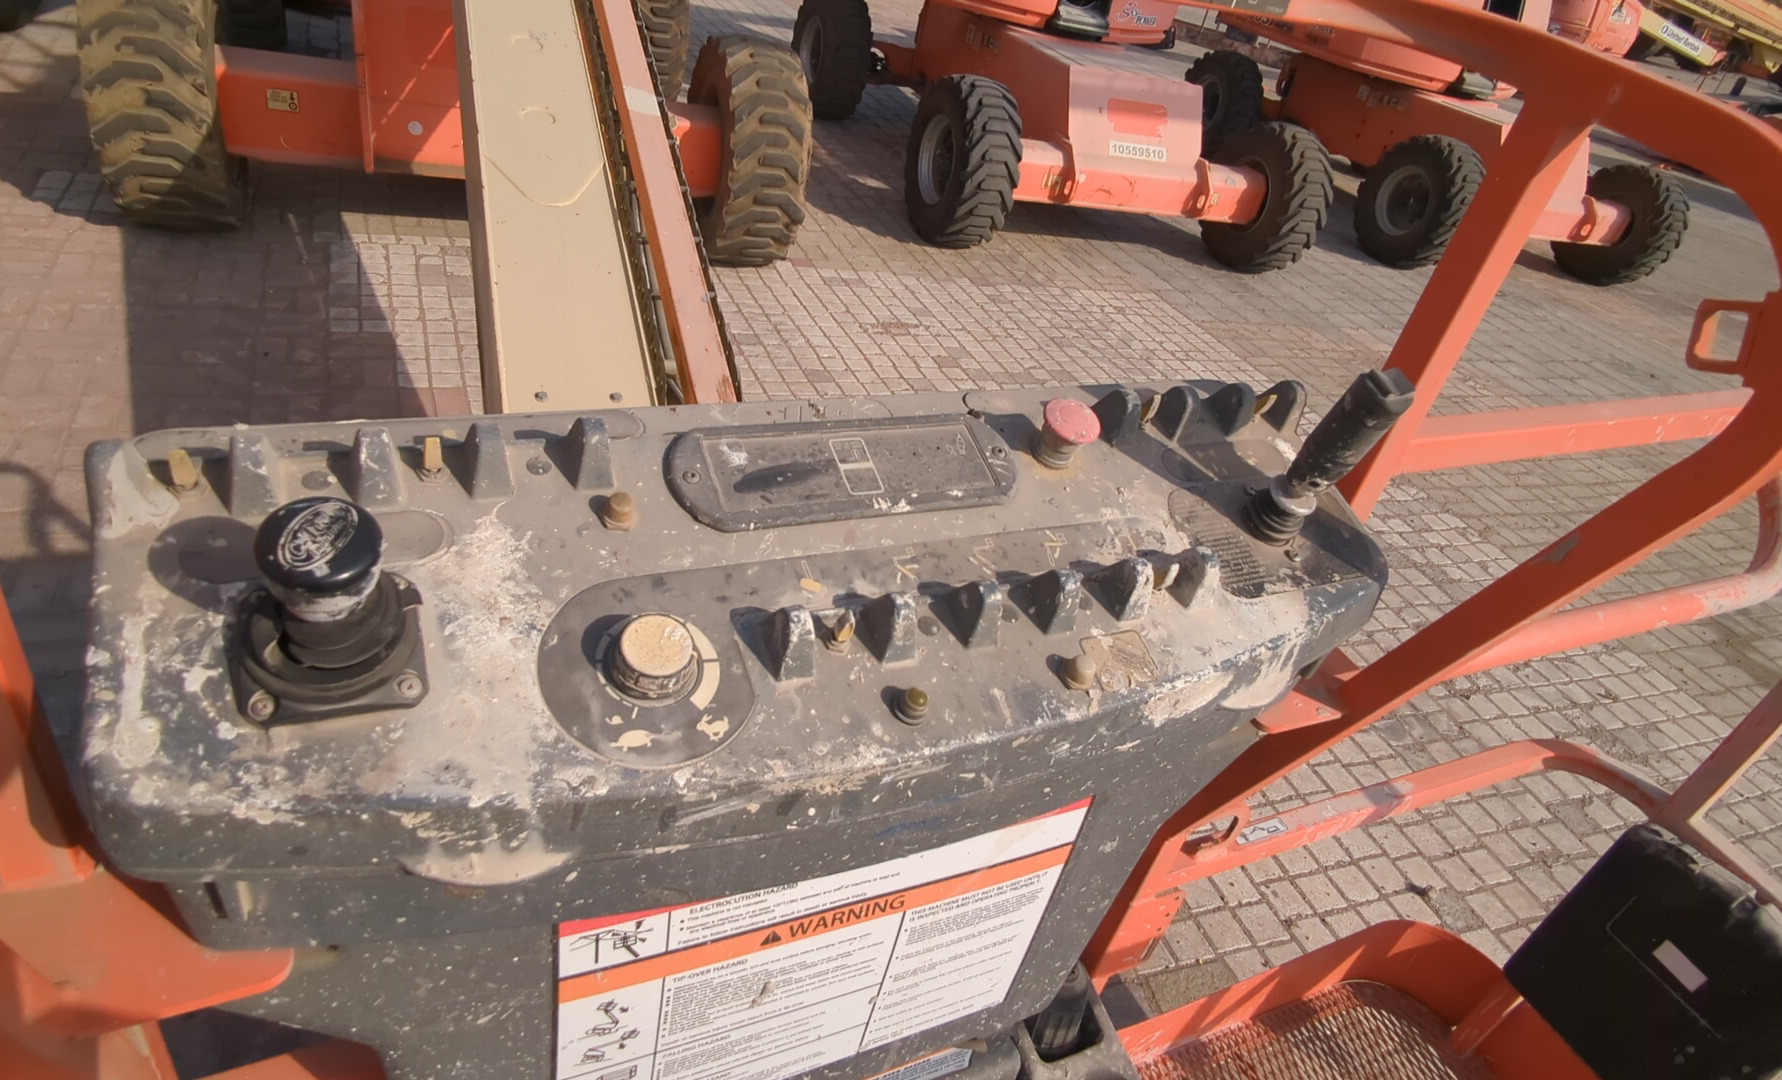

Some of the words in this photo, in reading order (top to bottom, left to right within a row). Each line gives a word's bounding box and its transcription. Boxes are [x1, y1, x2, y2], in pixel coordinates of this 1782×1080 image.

[1667, 28, 1685, 43] United
[1682, 36, 1701, 53] Rentals
[1111, 144, 1165, 160] 10559510
[689, 891, 761, 915] ELECTROCUTION
[762, 882, 799, 896] HAZARD
[911, 908, 926, 917] THIS
[927, 898, 960, 910] MACHINE
[961, 892, 980, 902] MUST
[980, 888, 995, 896] NOT
[1005, 879, 1023, 889] USED
[1023, 874, 1041, 883] UNTIL
[917, 905, 955, 920] INSPECTED
[955, 900, 971, 909] AND
[971, 889, 1008, 904] OPERATING
[789, 894, 906, 938] WARNING
[673, 967, 712, 984] TIP-OVER
[712, 958, 748, 976] HAZARD
[662, 1045, 697, 1059] FALLING
[697, 1033, 732, 1048] HAZARD
